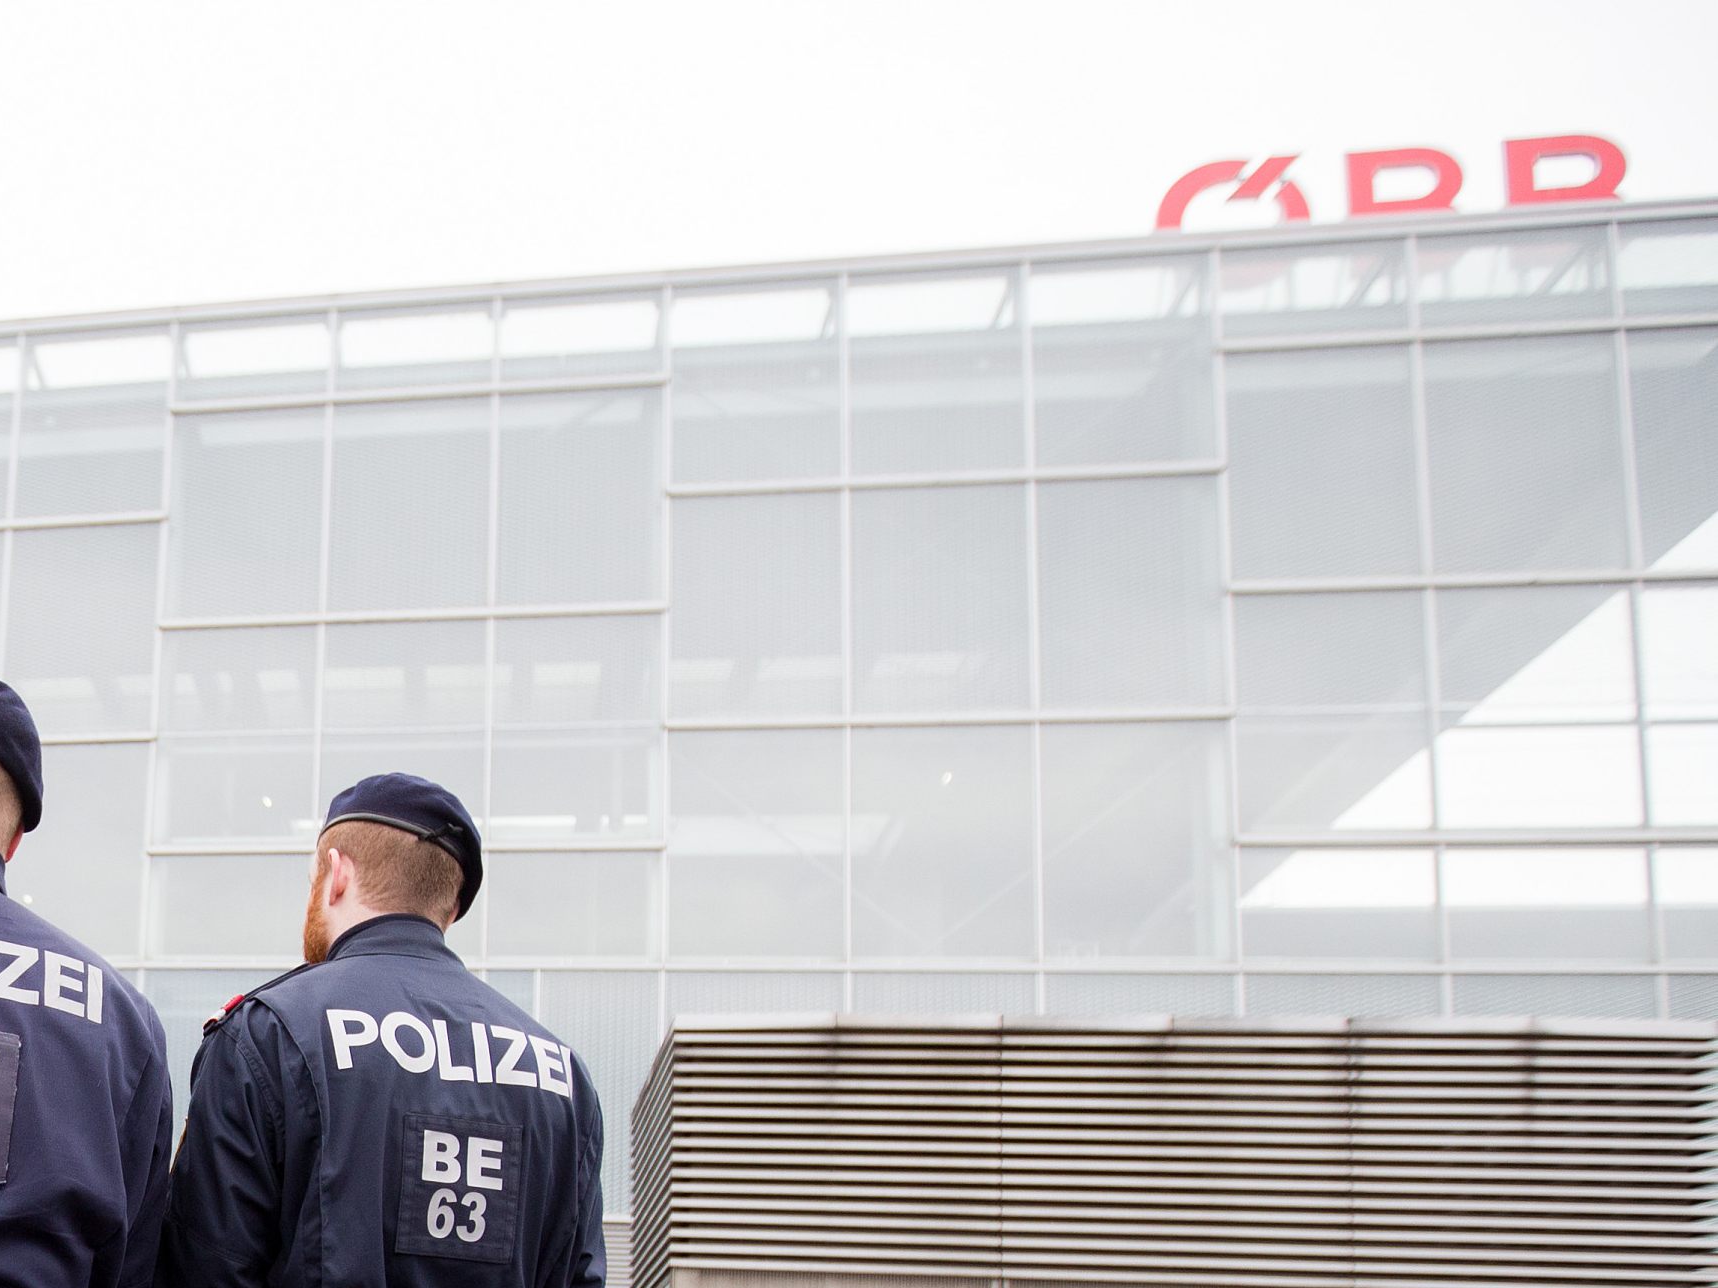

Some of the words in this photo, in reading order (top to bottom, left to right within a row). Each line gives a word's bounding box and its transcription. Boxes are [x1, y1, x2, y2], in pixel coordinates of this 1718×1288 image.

[326, 1009, 573, 1100] POLIZEI
[422, 1129, 503, 1190] BE
[427, 1188, 487, 1242] 63
